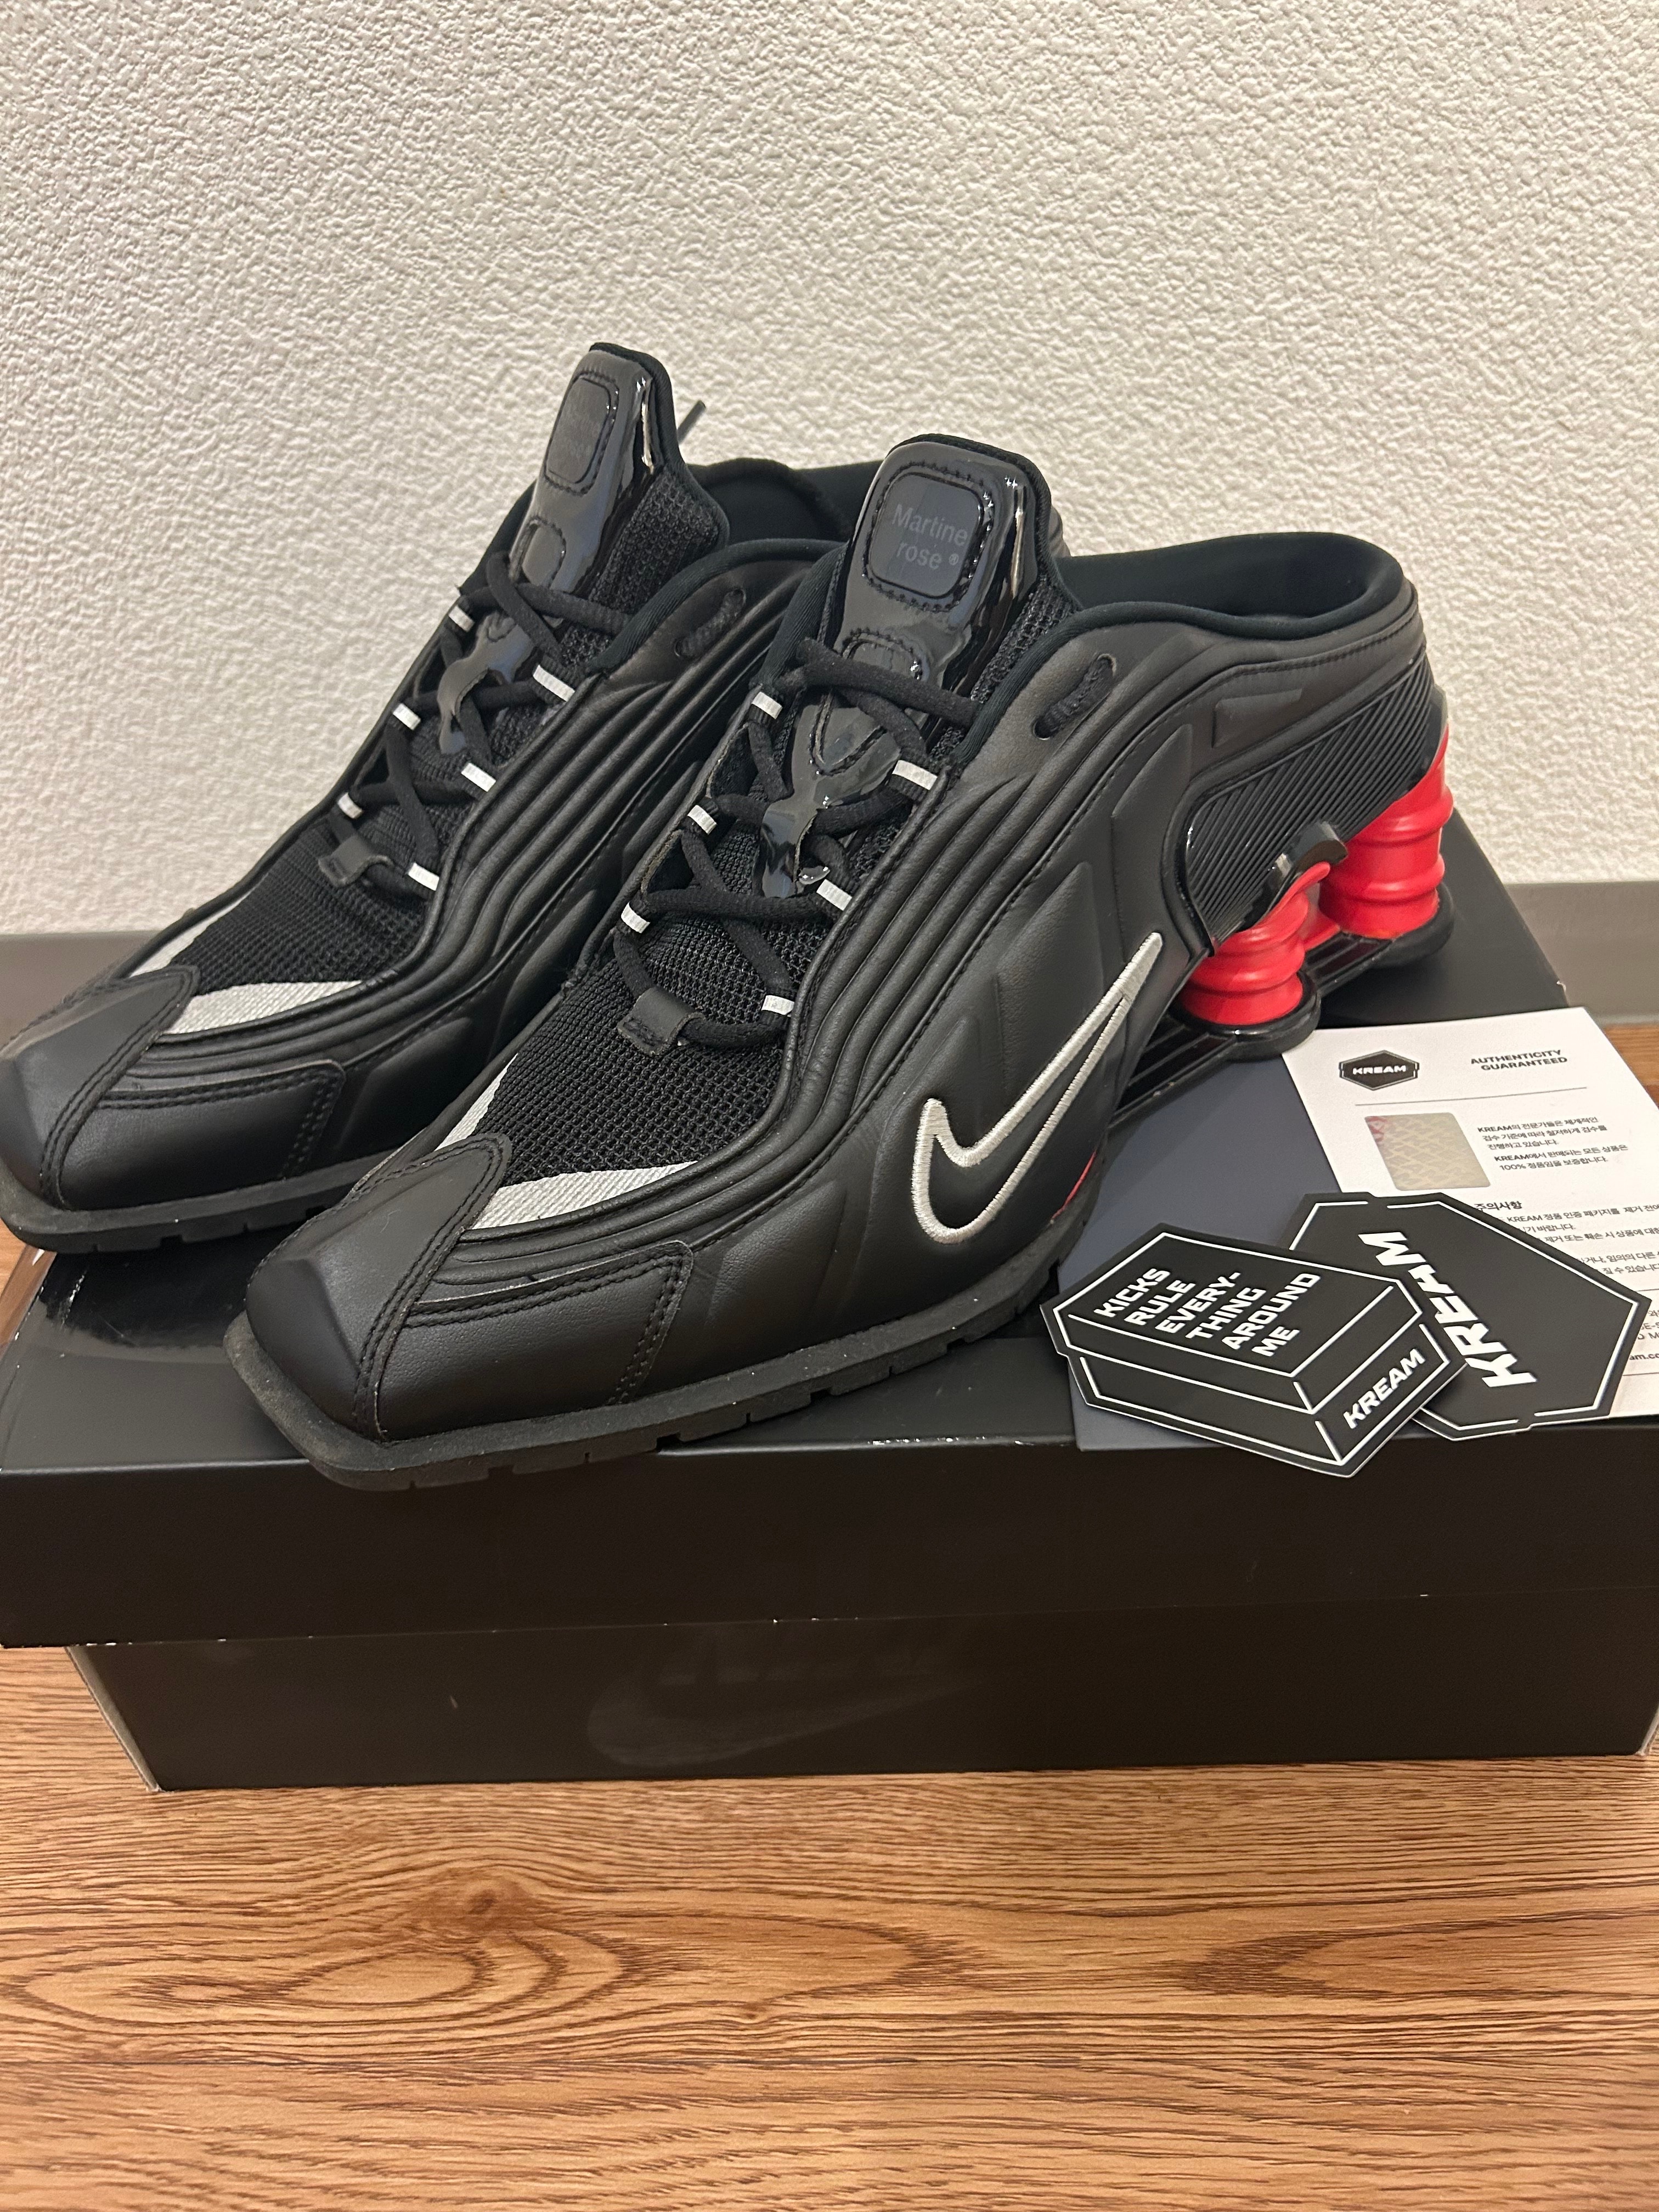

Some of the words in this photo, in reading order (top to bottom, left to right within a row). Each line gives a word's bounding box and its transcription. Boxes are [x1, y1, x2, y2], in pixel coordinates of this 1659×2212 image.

[891, 503, 969, 546] Martine
[895, 540, 943, 570] rose
[1471, 1049, 1561, 1065] AUTHENTICITY
[1481, 1057, 1567, 1070] GUARANTEED
[1352, 1065, 1407, 1075] KREAM
[1477, 1124, 1521, 1132] KREAM의
[1546, 1127, 1581, 1136] 철저하게
[1522, 1138, 1559, 1148] 있습니다.
[1494, 1152, 1547, 1161] KREAM에서
[1547, 1149, 1582, 1158] 판매되는
[1602, 1144, 1628, 1153] 상품은
[1527, 1160, 1562, 1169] 정품임을
[1474, 1200, 1522, 1212] 주의사항
[1583, 1208, 1620, 1216] 패키지를
[1616, 1229, 1644, 1238] 상품에
[1606, 1253, 1636, 1262] 임의의
[1635, 1251, 1656, 1260] 다른
[1094, 1267, 1172, 1318] KICKS
[1124, 1279, 1196, 1325] RULE
[1155, 1271, 1242, 1334] EVERY-
[1358, 1231, 1537, 1388] KREAM
[1186, 1288, 1266, 1339] THING
[1221, 1273, 1321, 1350] AROUND
[1251, 1326, 1300, 1357] ME
[1343, 1348, 1425, 1429] KREAM
